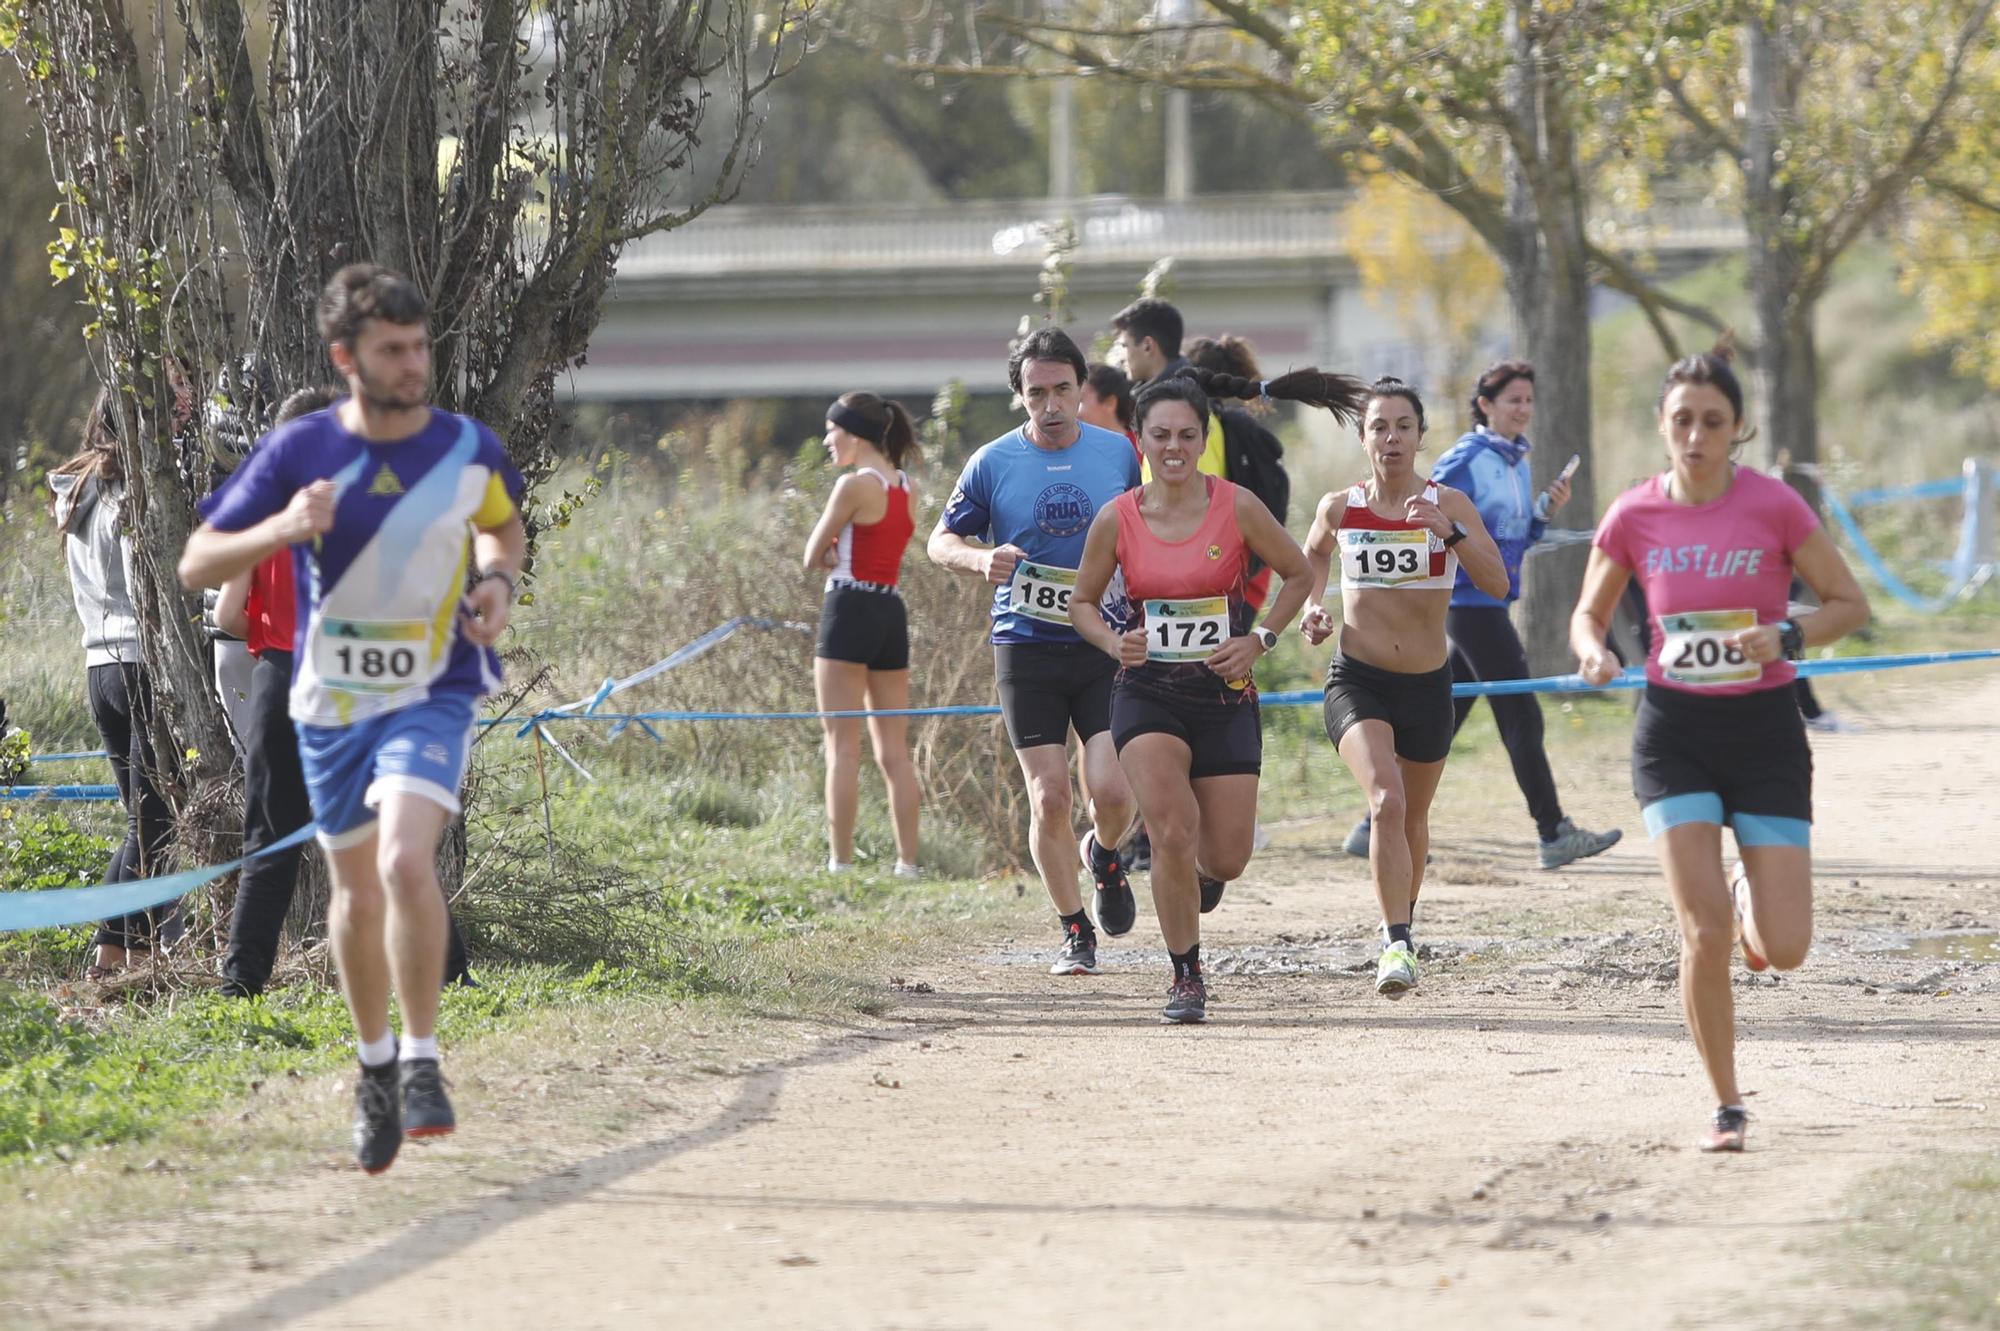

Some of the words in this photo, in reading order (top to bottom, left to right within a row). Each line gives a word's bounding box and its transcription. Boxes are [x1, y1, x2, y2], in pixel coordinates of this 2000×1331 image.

[1046, 501, 1080, 520] RUA
[1356, 549, 1418, 574] 193
[1647, 544, 1708, 575] FAST
[1706, 549, 1764, 578] LIFE
[1021, 582, 1072, 612] 189
[1157, 621, 1220, 647] 172
[336, 646, 415, 678] 180
